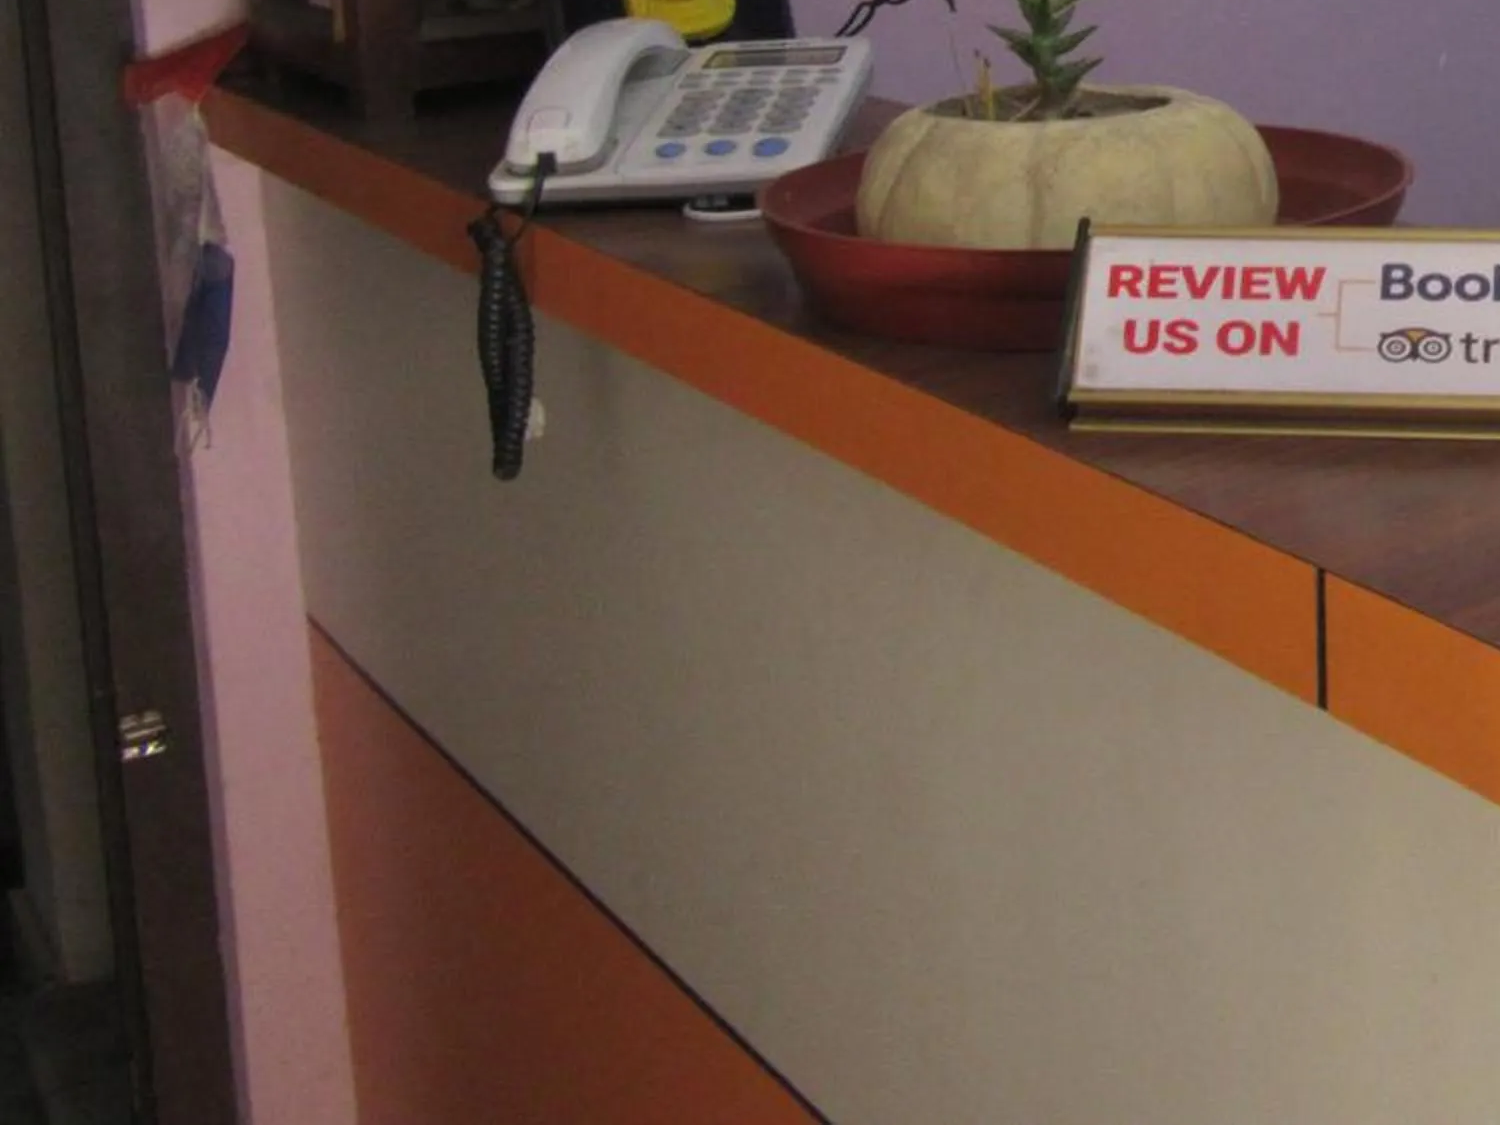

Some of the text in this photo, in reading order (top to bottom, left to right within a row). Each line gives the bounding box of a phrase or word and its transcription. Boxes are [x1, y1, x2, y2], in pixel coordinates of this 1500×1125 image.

[1107, 265, 1326, 300] REVIEW
[1122, 320, 1202, 356] US
[1216, 318, 1299, 356] ON
